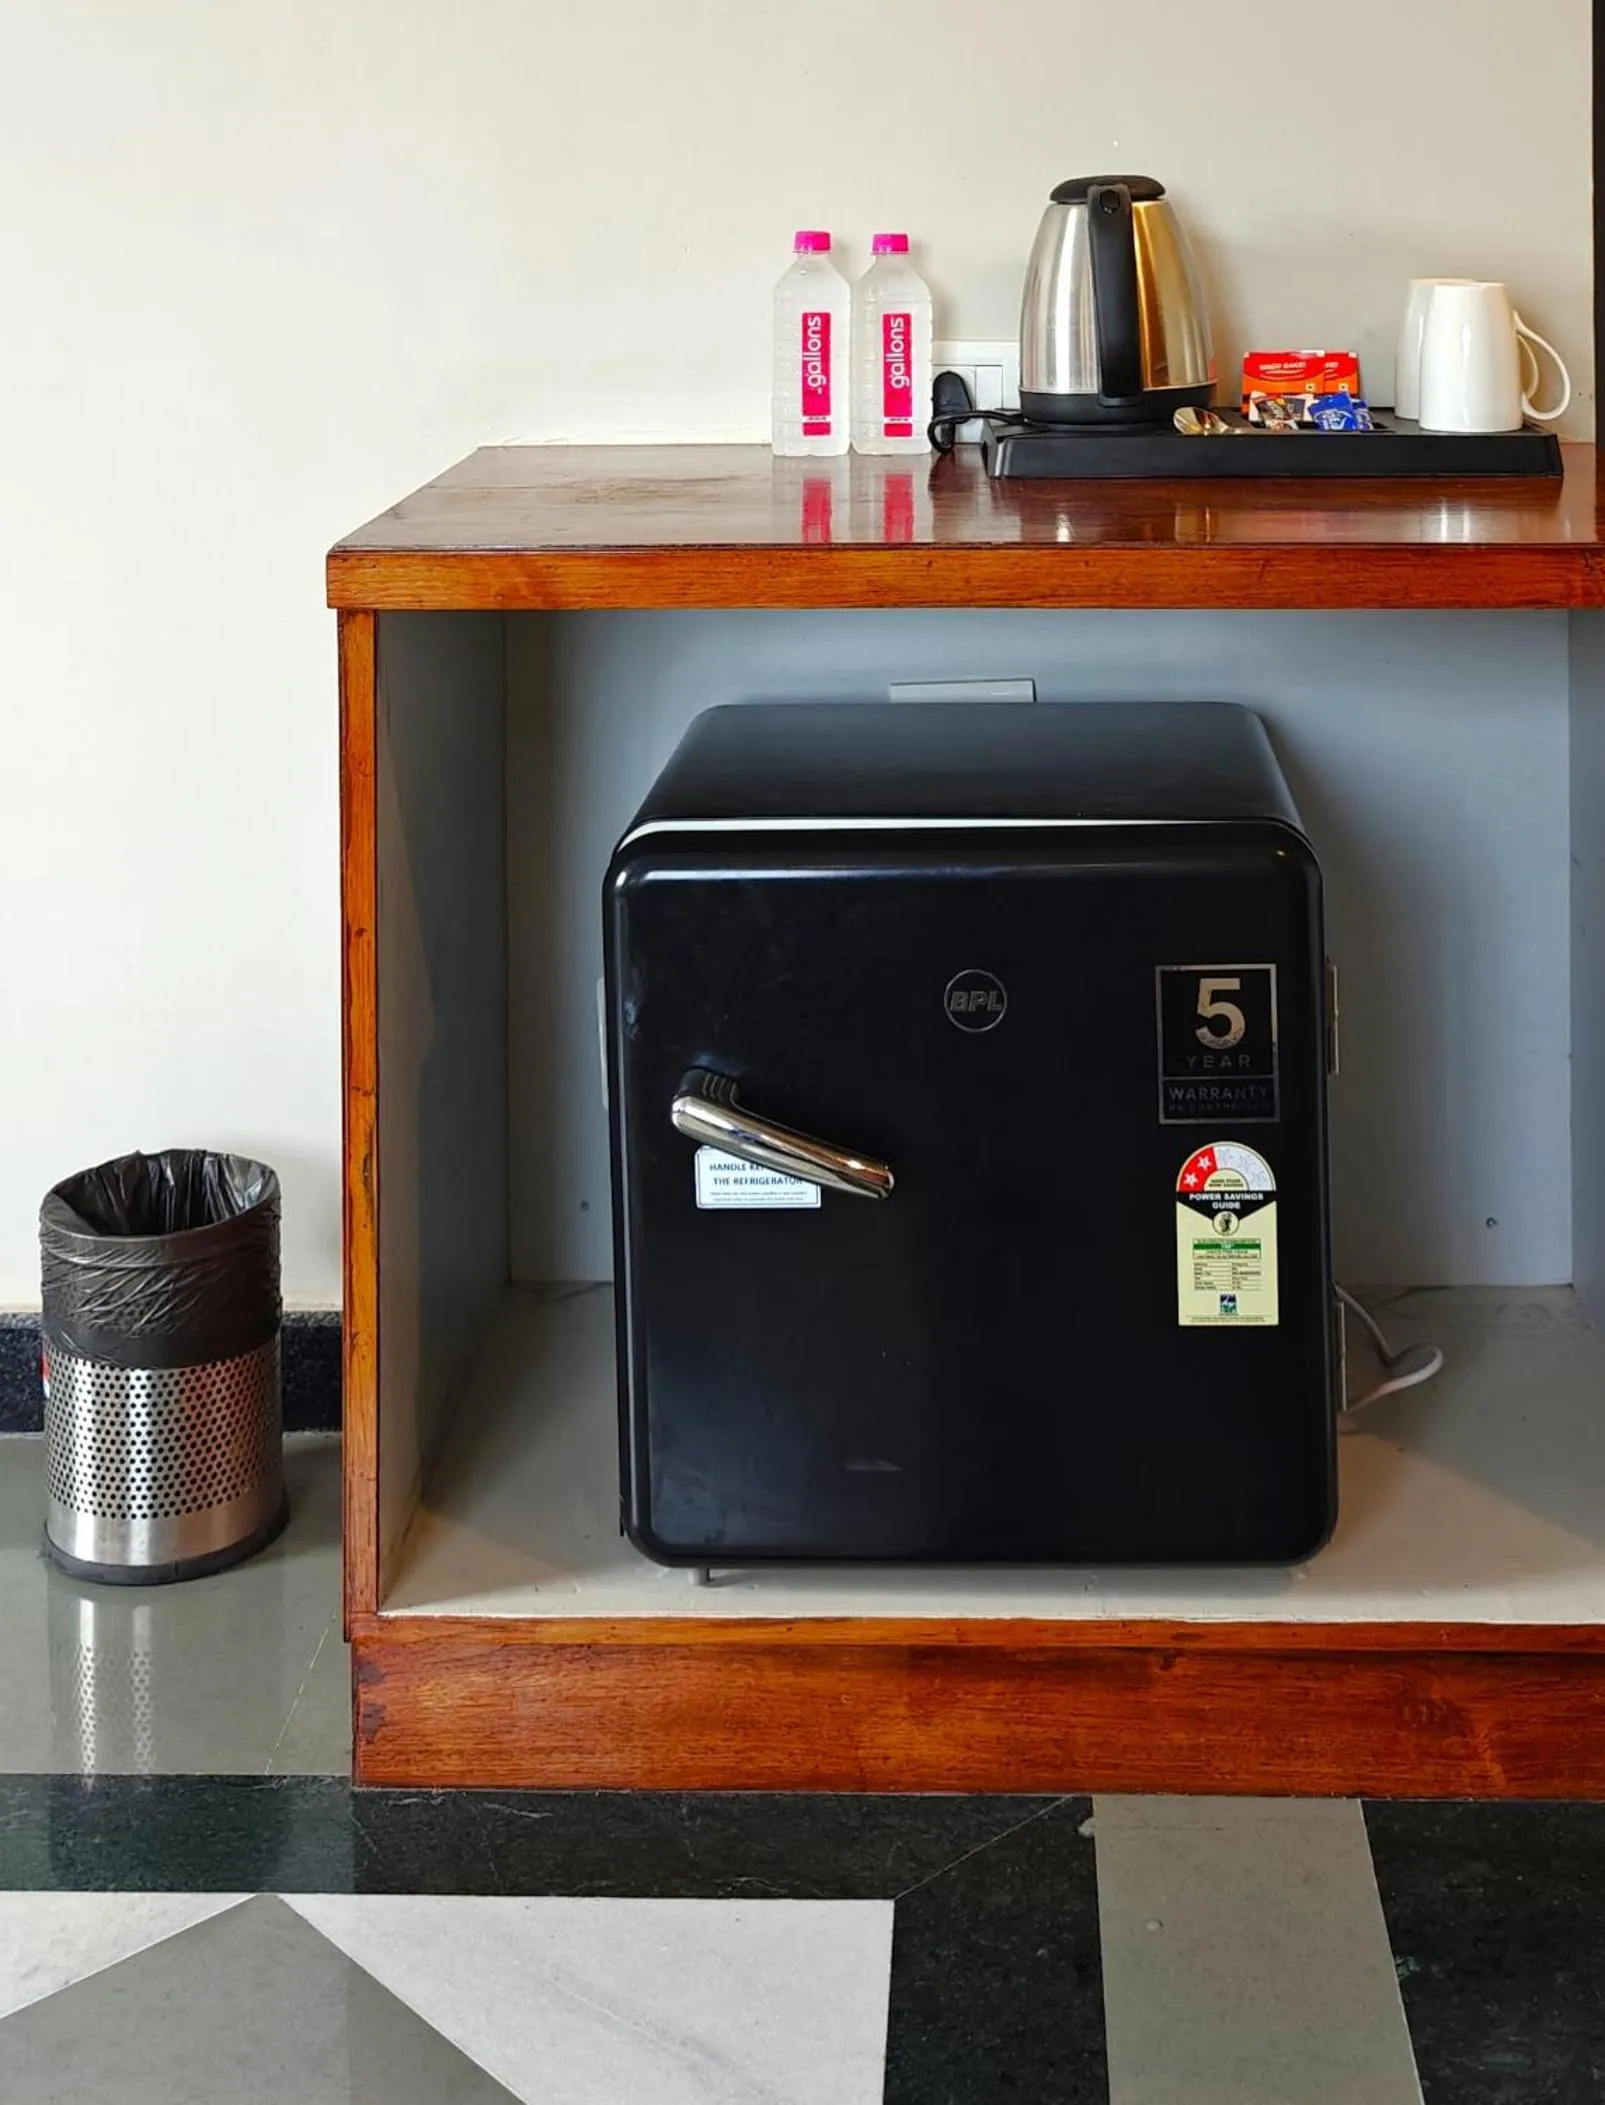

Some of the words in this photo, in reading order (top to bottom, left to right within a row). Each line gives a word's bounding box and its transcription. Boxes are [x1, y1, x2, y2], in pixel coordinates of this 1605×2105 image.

[885, 317, 910, 389] gallons
[950, 991, 1001, 1012] BPL
[1195, 977, 1246, 1050] 5
[1186, 1054, 1252, 1069] YEAR
[1168, 1086, 1268, 1100] WARRANTY
[709, 1163, 747, 1172] HANDLE
[713, 1177, 732, 1186] THE
[1188, 1193, 1222, 1201] POWER
[1224, 1193, 1264, 1201] SAVINGS
[1211, 1201, 1241, 1210] GUIDE
